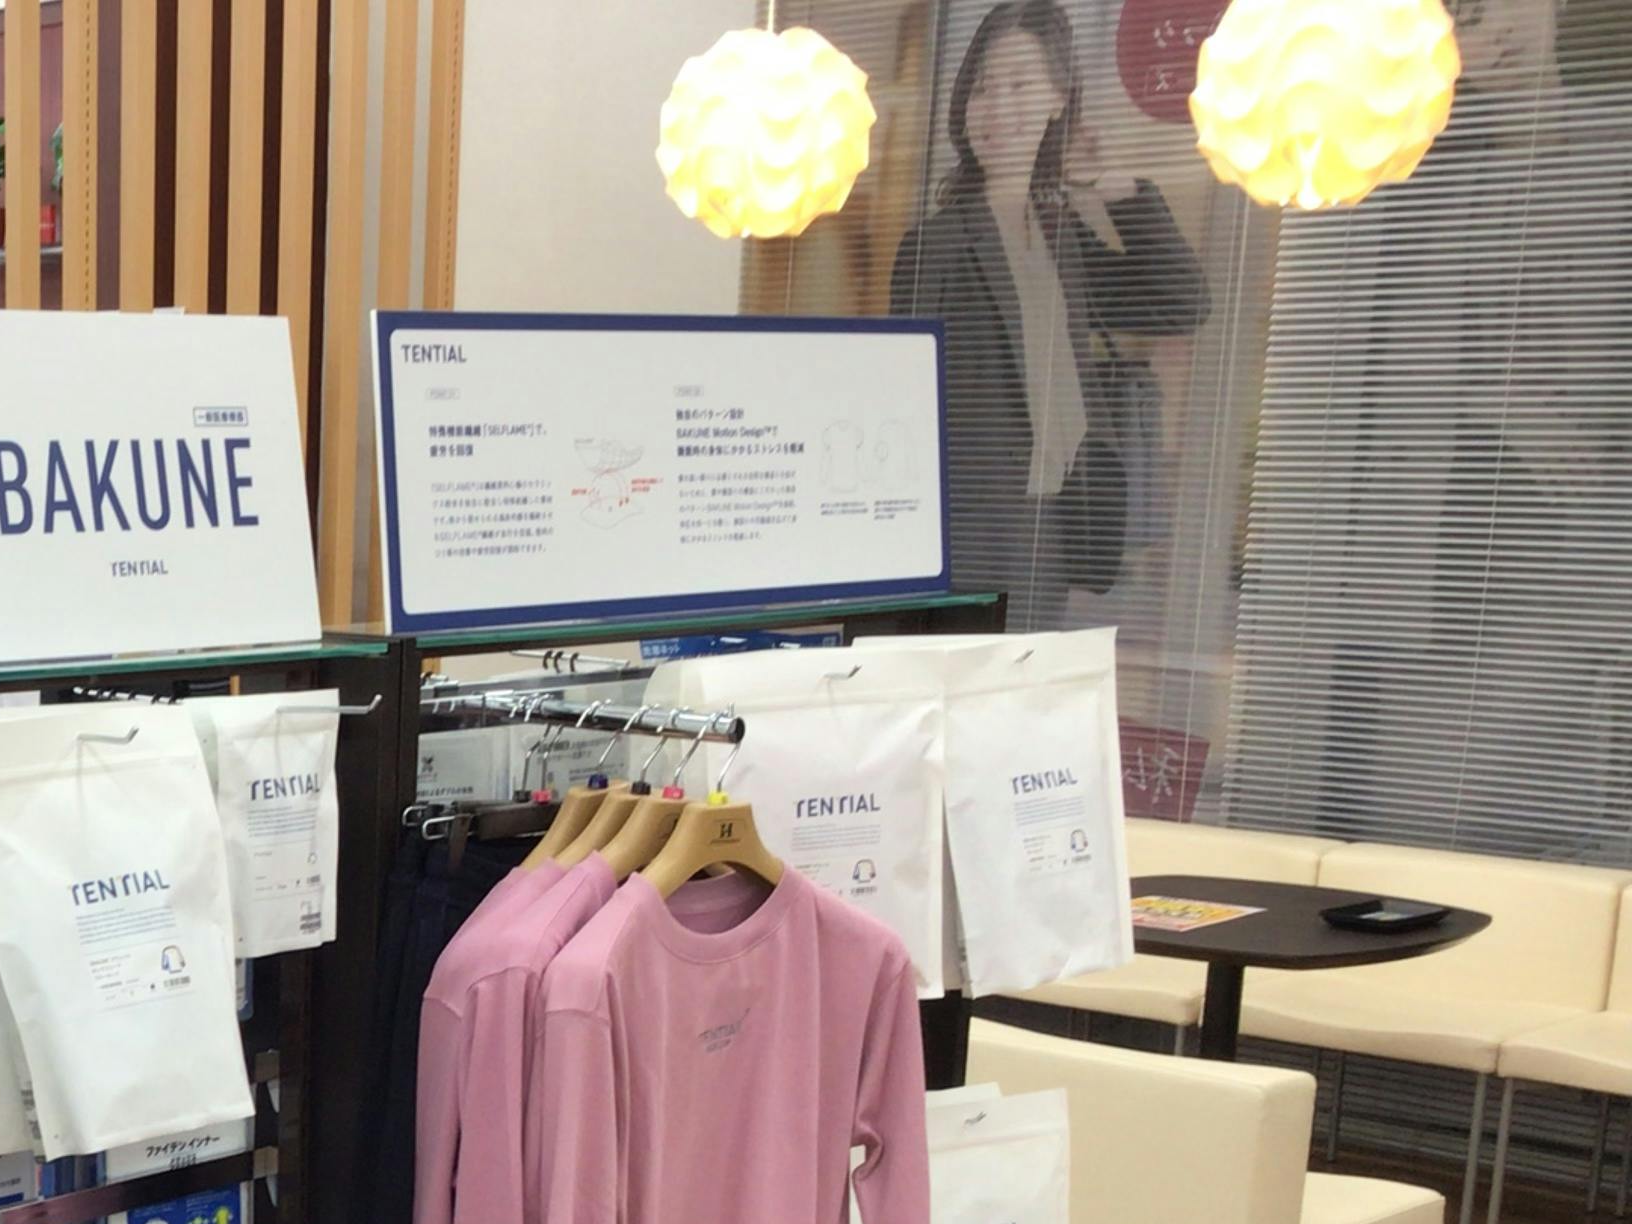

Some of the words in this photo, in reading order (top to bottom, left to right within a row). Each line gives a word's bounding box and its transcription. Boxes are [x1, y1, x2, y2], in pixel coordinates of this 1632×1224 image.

[401, 343, 467, 363] TENTIAL
[110, 560, 169, 577] TENTIAL
[246, 772, 321, 801] TENTIAL
[1010, 767, 1078, 795] TENTIAL
[793, 792, 881, 818] TENTIAL
[67, 869, 171, 906] TENTIAL
